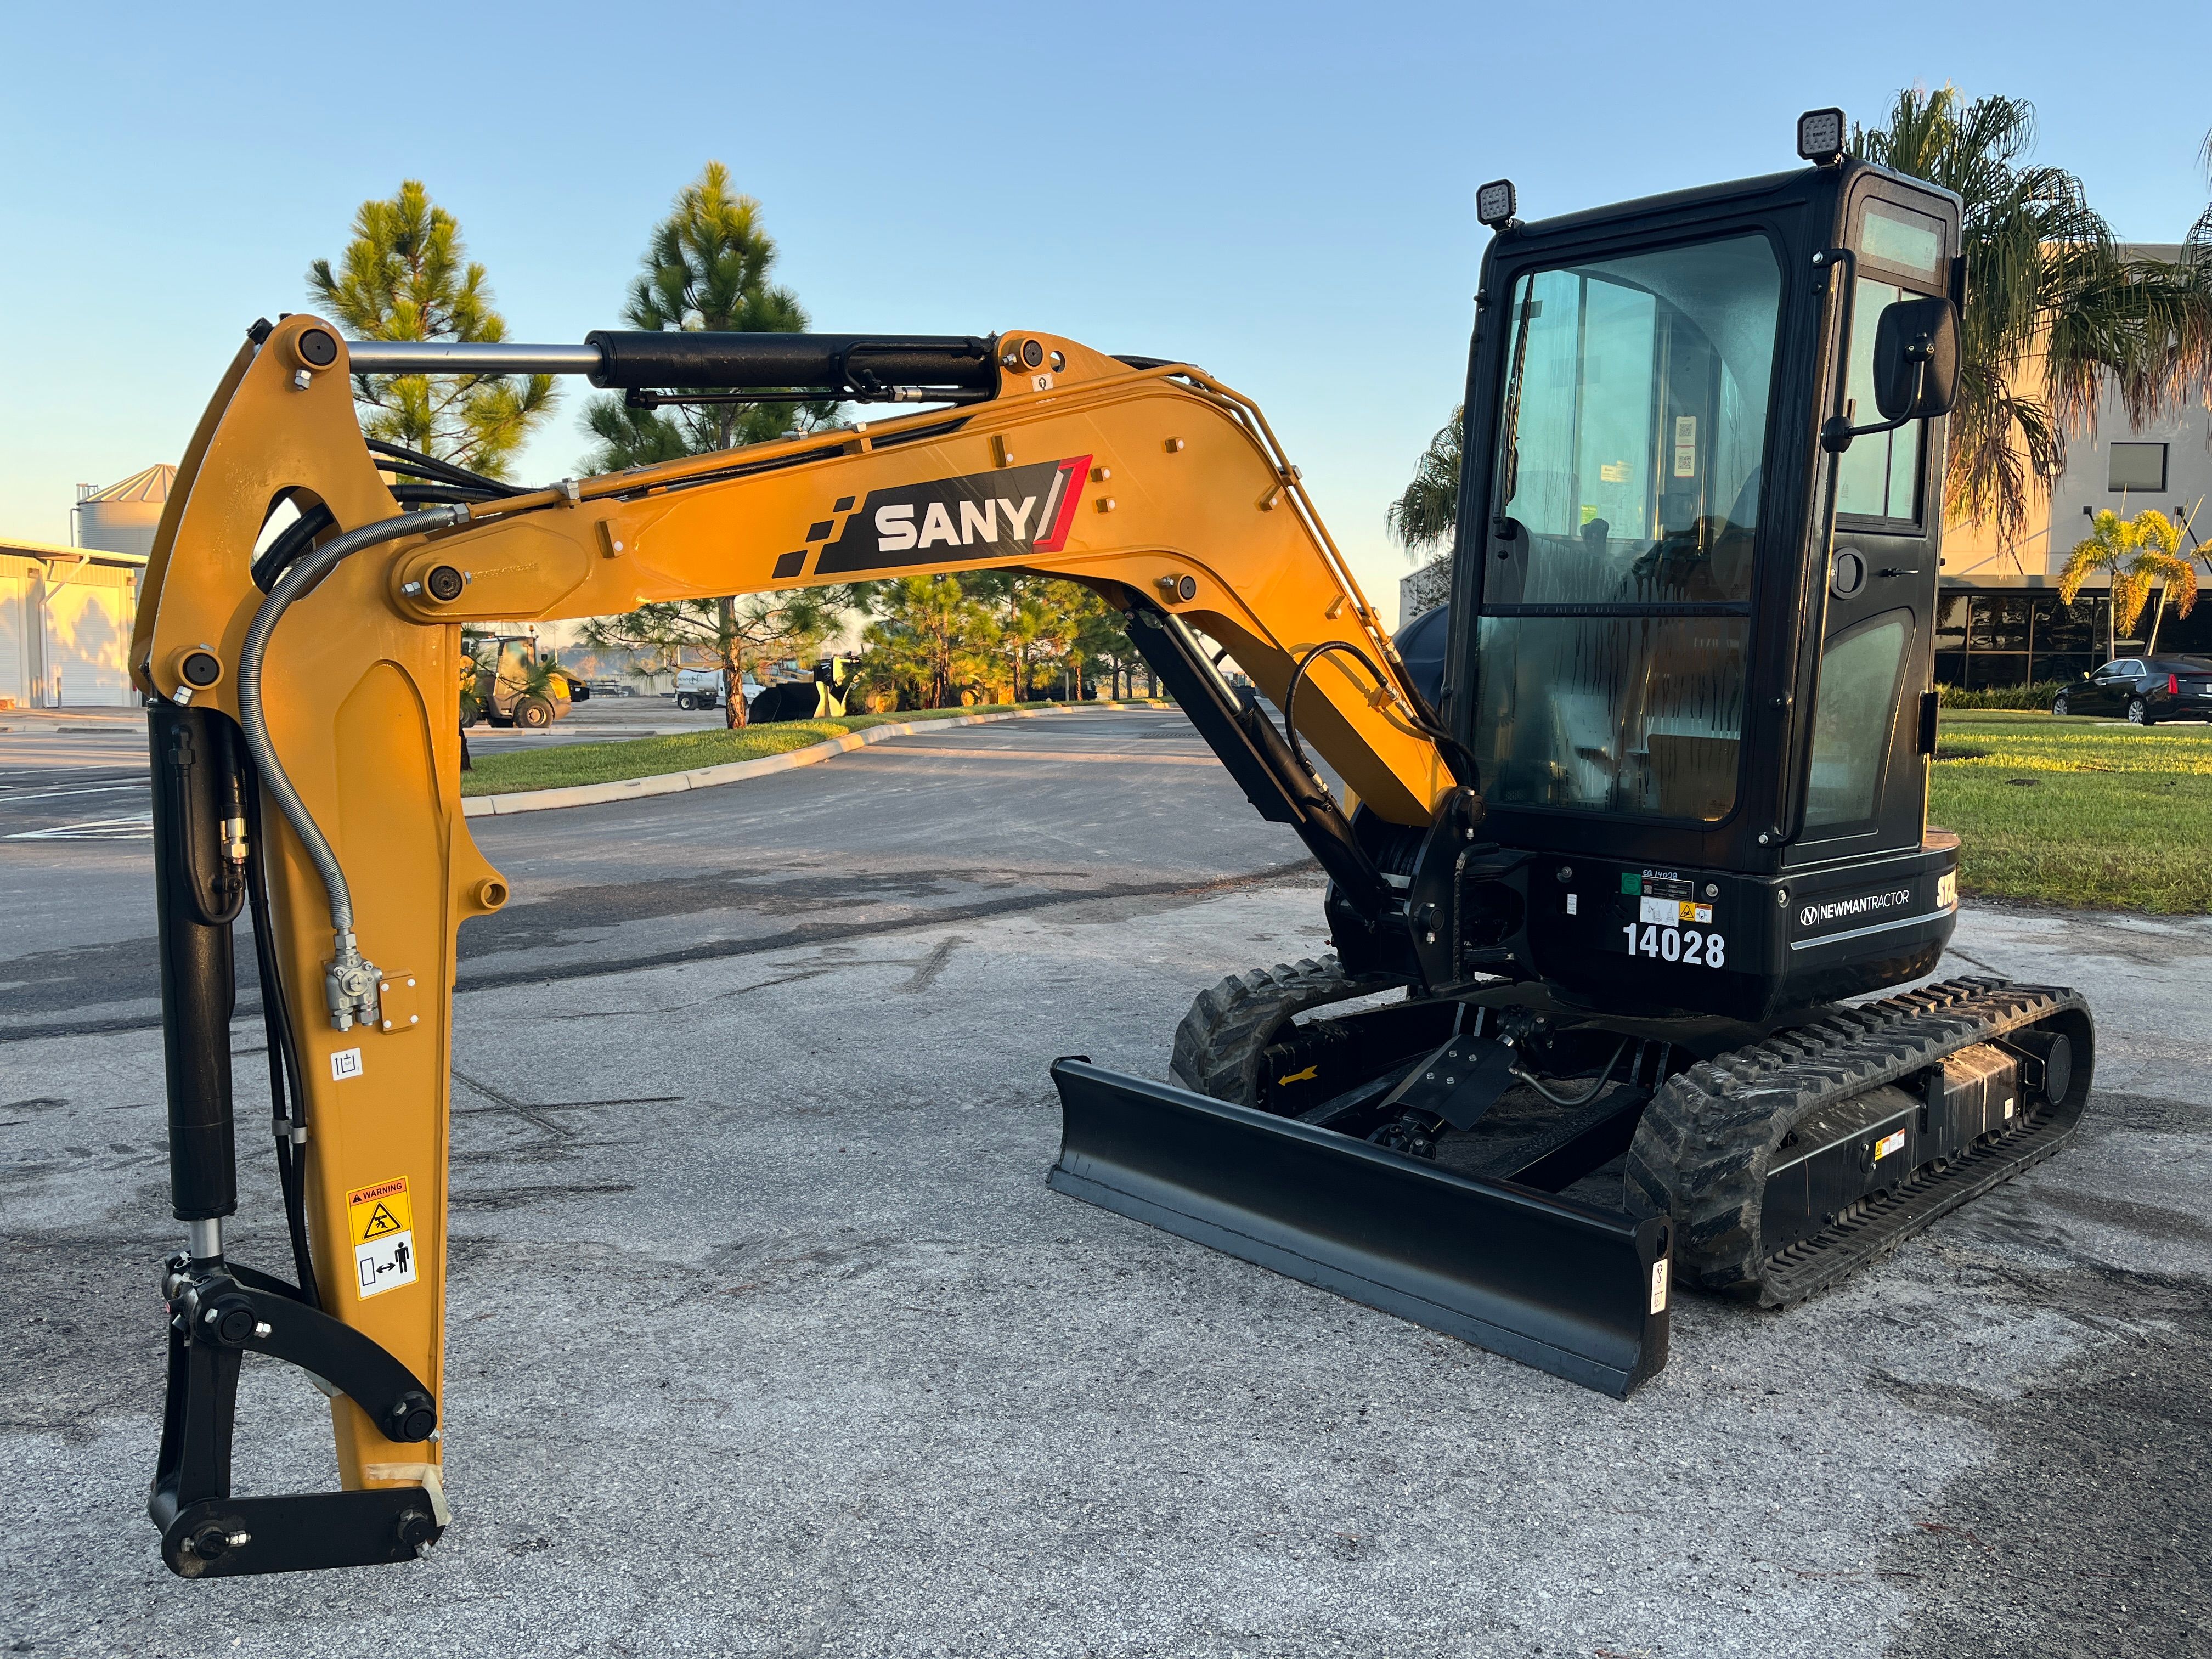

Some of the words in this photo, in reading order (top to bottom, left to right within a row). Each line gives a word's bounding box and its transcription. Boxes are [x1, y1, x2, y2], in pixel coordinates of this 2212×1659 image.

[874, 496, 1037, 552] SANY
[1655, 871, 1678, 880] 14028
[1623, 923, 1725, 968] 14028
[363, 1182, 403, 1199] WARNING
